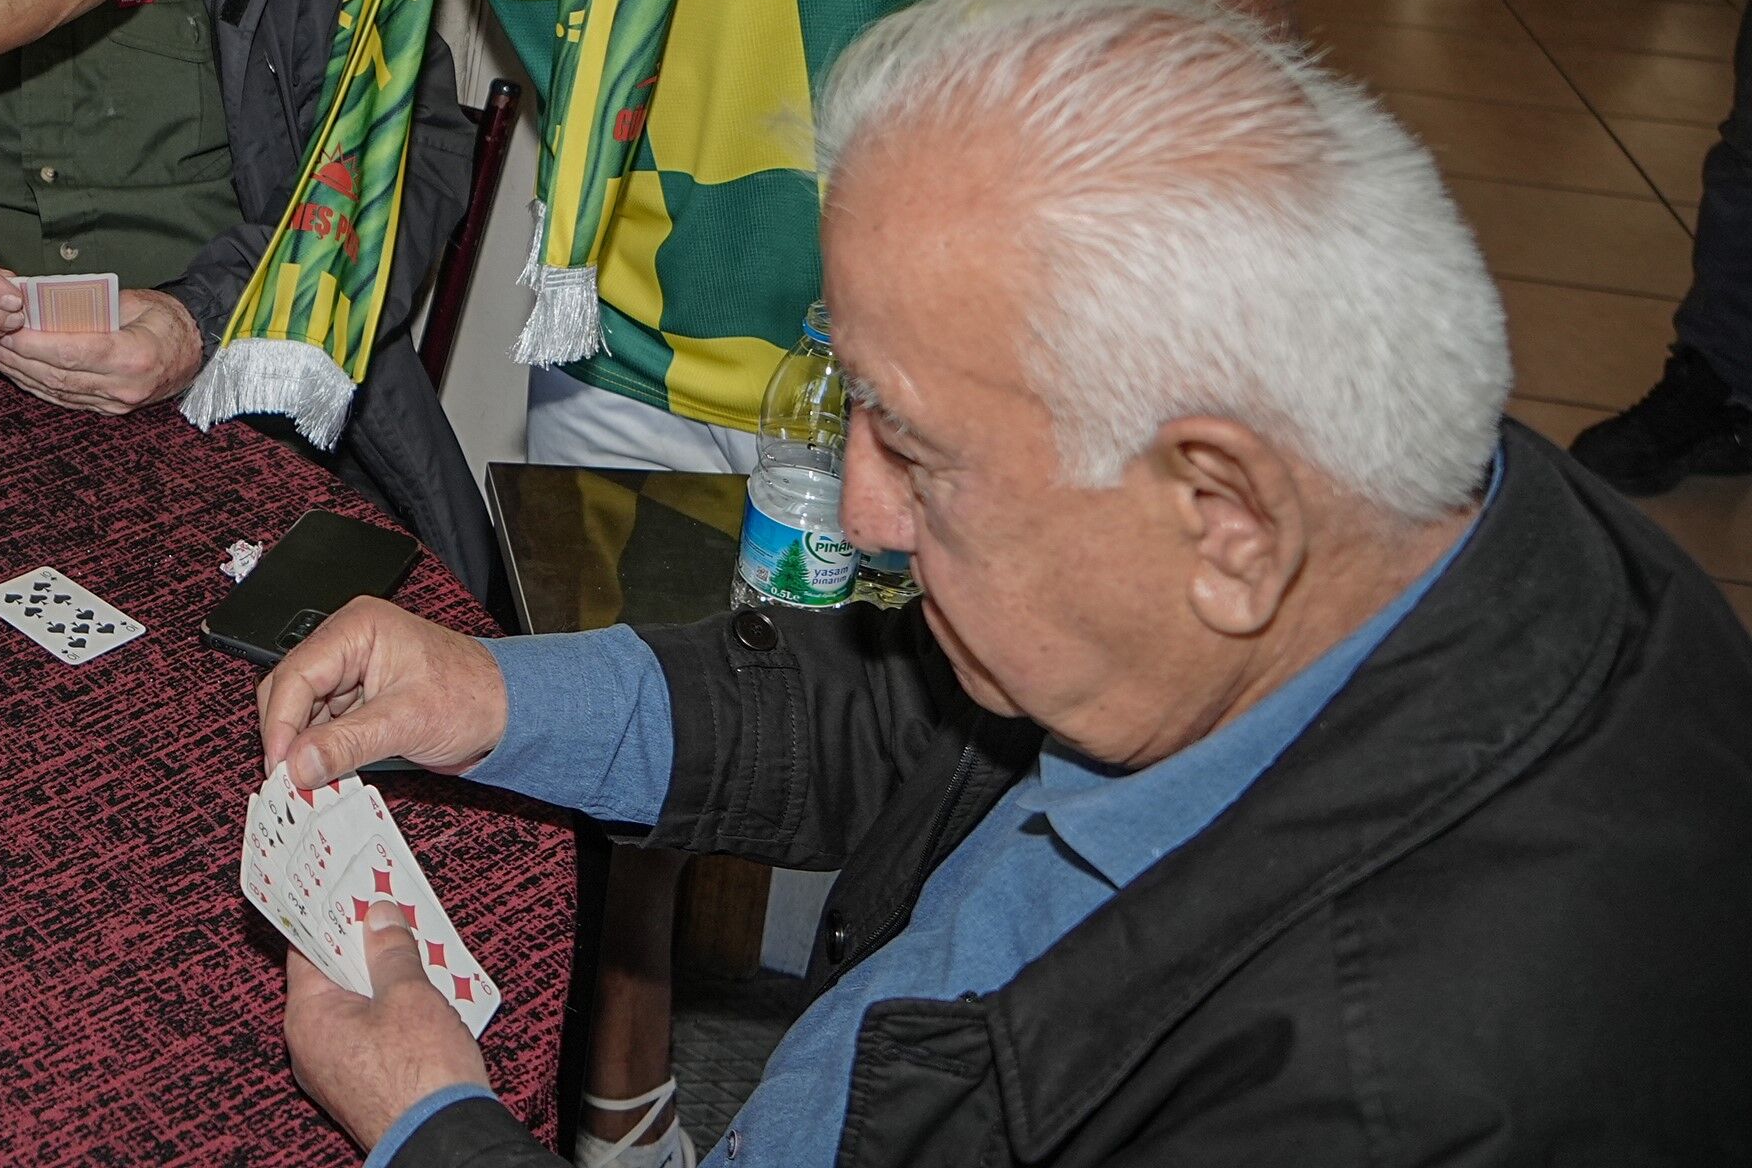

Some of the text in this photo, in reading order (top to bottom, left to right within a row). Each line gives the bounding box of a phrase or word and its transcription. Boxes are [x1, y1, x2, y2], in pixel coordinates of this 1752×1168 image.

[282, 774, 291, 790] 6
[268, 799, 278, 815] 6
[369, 795, 380, 811] A
[258, 822, 269, 838] 8
[317, 828, 327, 845] A
[251, 832, 261, 849] 8
[310, 843, 320, 859] 2
[376, 843, 387, 858] 9
[304, 862, 315, 878] 2
[293, 873, 304, 888] 3
[288, 892, 299, 907] 3
[335, 901, 345, 916] 9
[324, 932, 335, 947] 9
